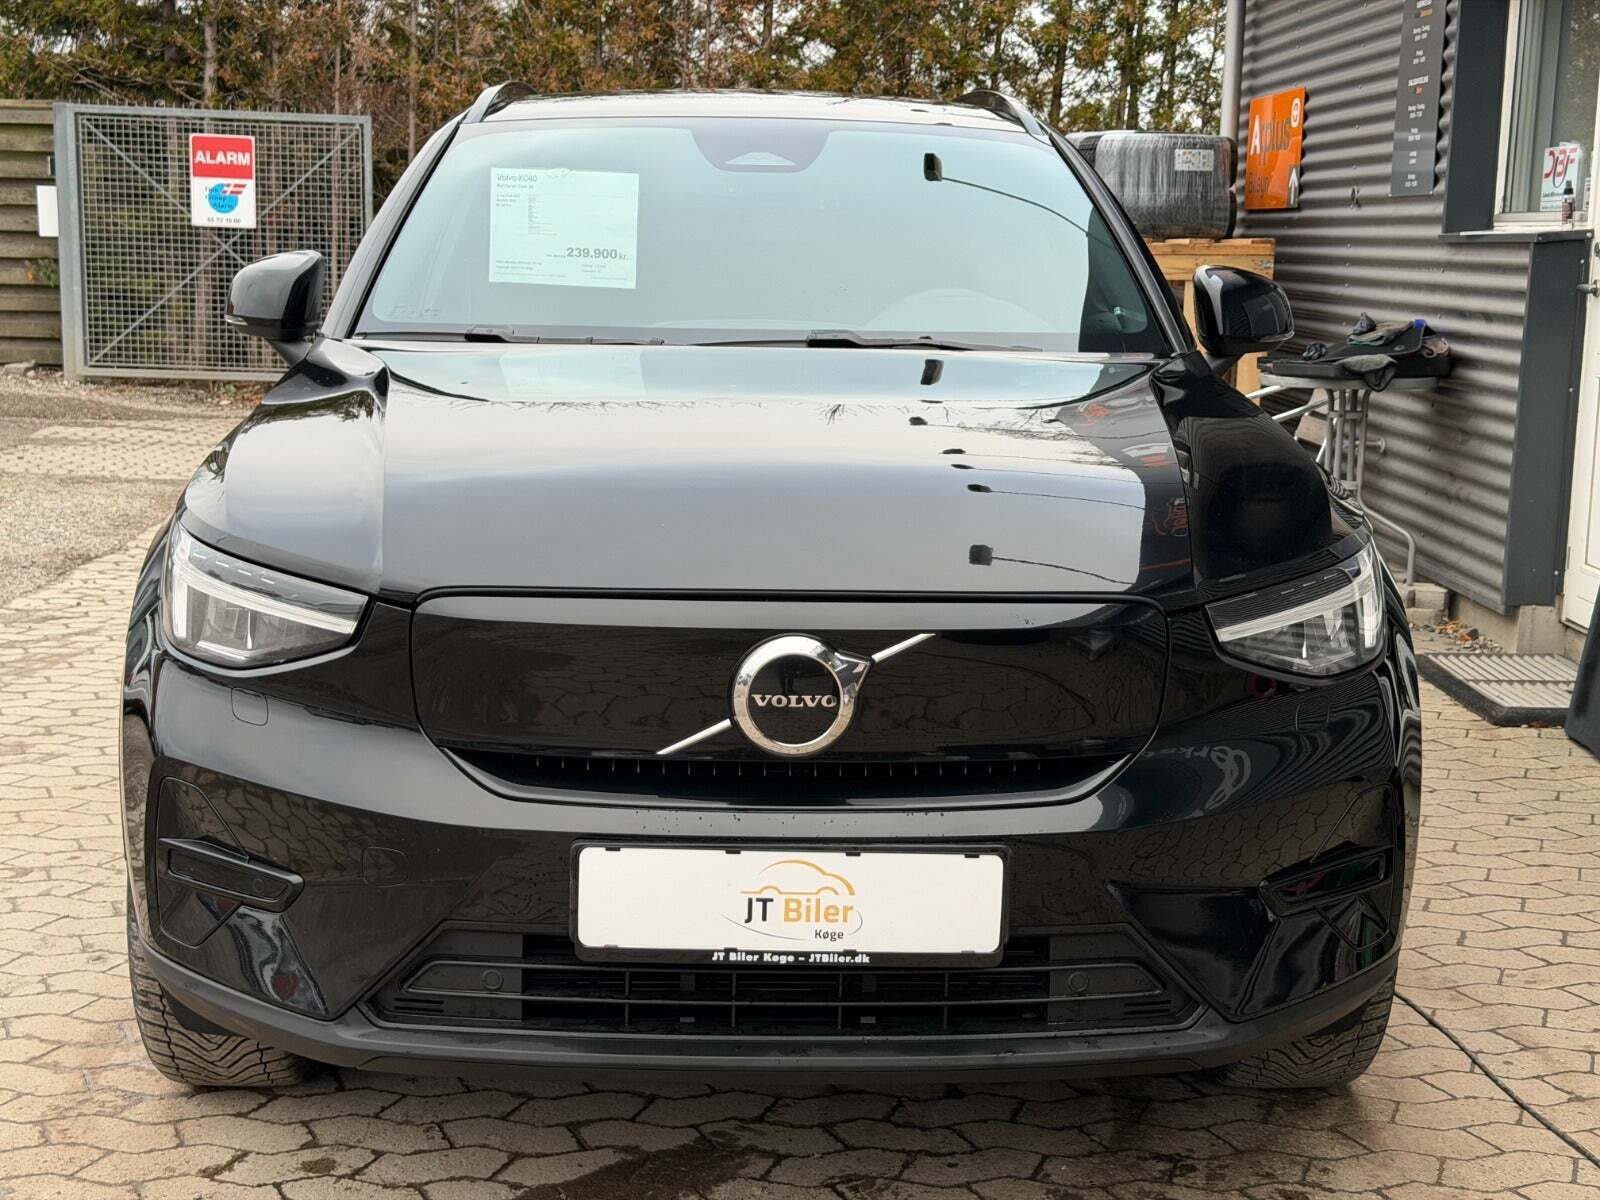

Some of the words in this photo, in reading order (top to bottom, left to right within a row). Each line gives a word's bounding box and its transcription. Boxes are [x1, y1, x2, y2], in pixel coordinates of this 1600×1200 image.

[195, 150, 251, 167] ALARM
[497, 174, 517, 182] Volvo
[566, 247, 618, 260] 239.900
[751, 694, 837, 708] VOLVO
[744, 897, 774, 924] JT
[783, 897, 854, 923] Biler
[814, 928, 844, 942] Køge
[712, 951, 725, 961] JT
[729, 952, 759, 962] Biler
[809, 953, 871, 964] JTBiler.dk
